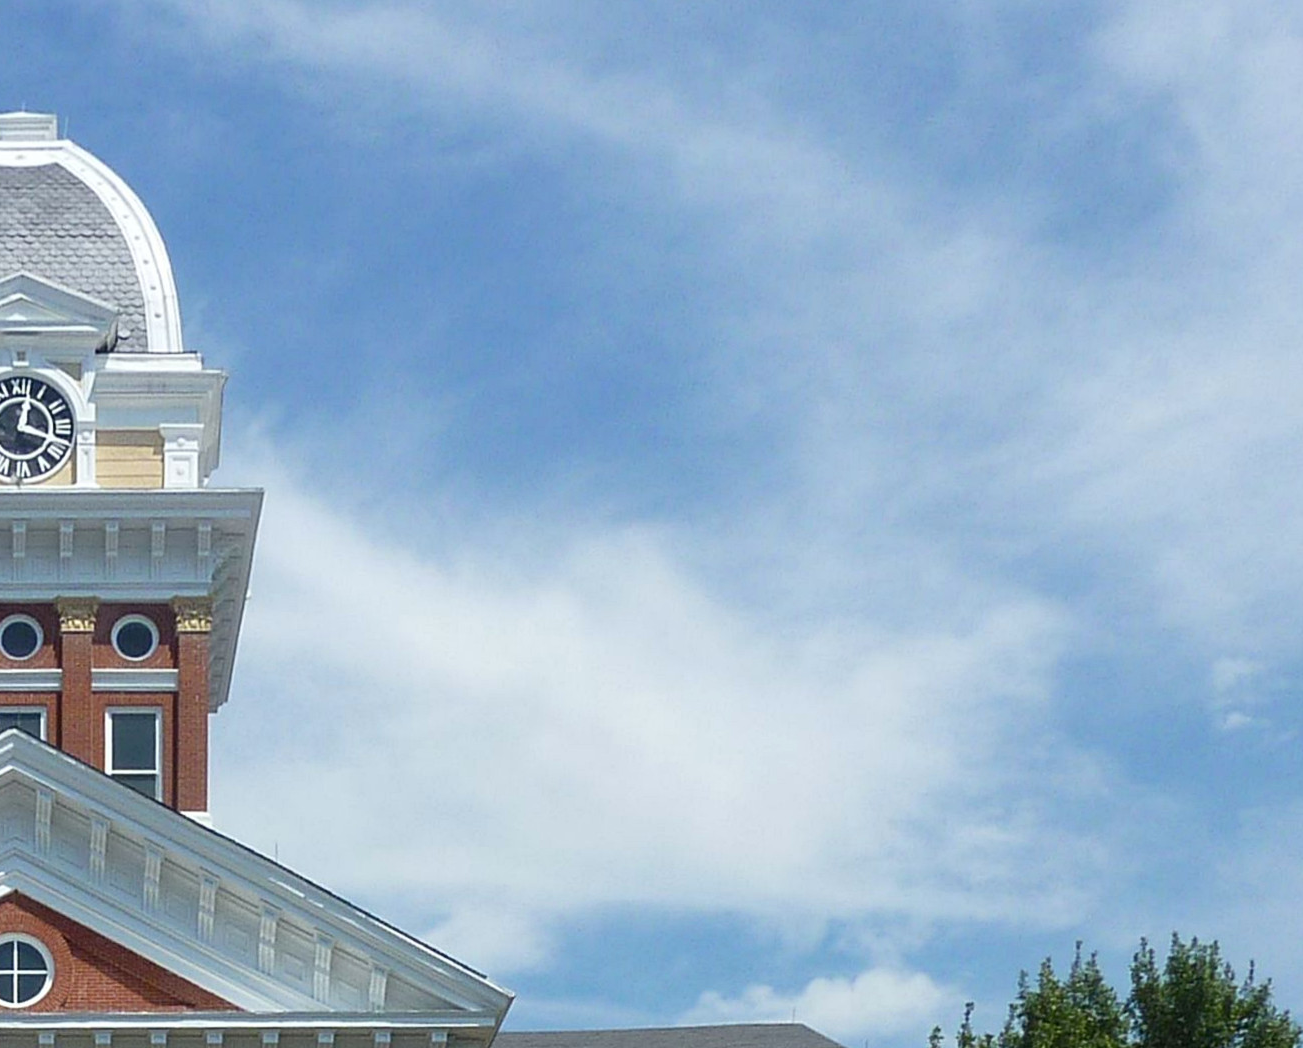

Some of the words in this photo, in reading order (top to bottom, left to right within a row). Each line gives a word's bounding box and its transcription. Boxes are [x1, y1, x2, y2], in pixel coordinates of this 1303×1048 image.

[37, 384, 47, 399] I
[48, 399, 66, 414] II
[55, 418, 72, 435] III
[47, 440, 68, 460] III
[16, 460, 31, 477] VI
[37, 455, 51, 472] V
